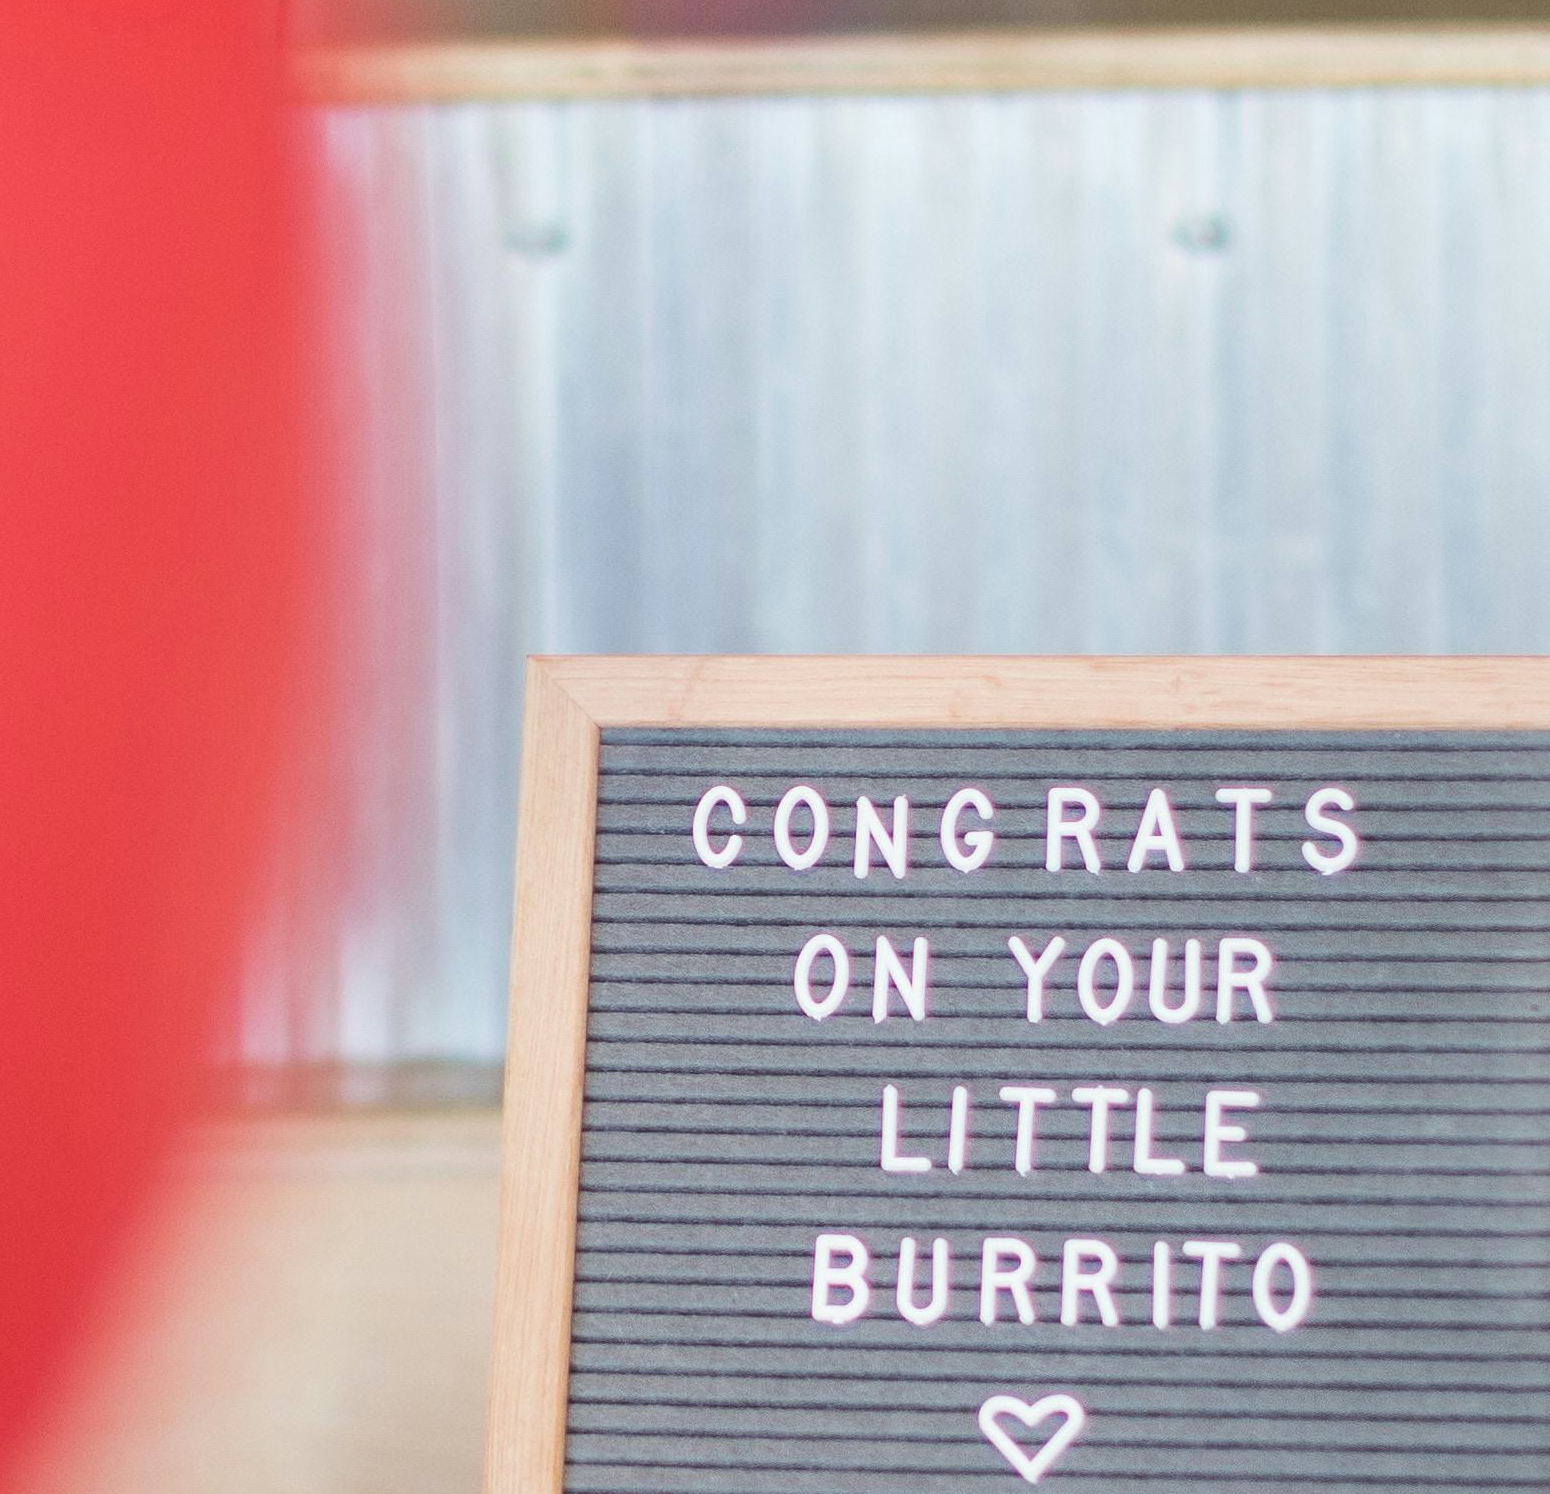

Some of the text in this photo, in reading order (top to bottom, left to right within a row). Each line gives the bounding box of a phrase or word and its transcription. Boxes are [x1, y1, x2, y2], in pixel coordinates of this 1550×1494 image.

[691, 784, 1361, 881] CONGRATS
[792, 932, 1275, 1028] ON YOUR
[879, 1082, 1263, 1181] LITTLE
[810, 1232, 1314, 1336] BURRITO
